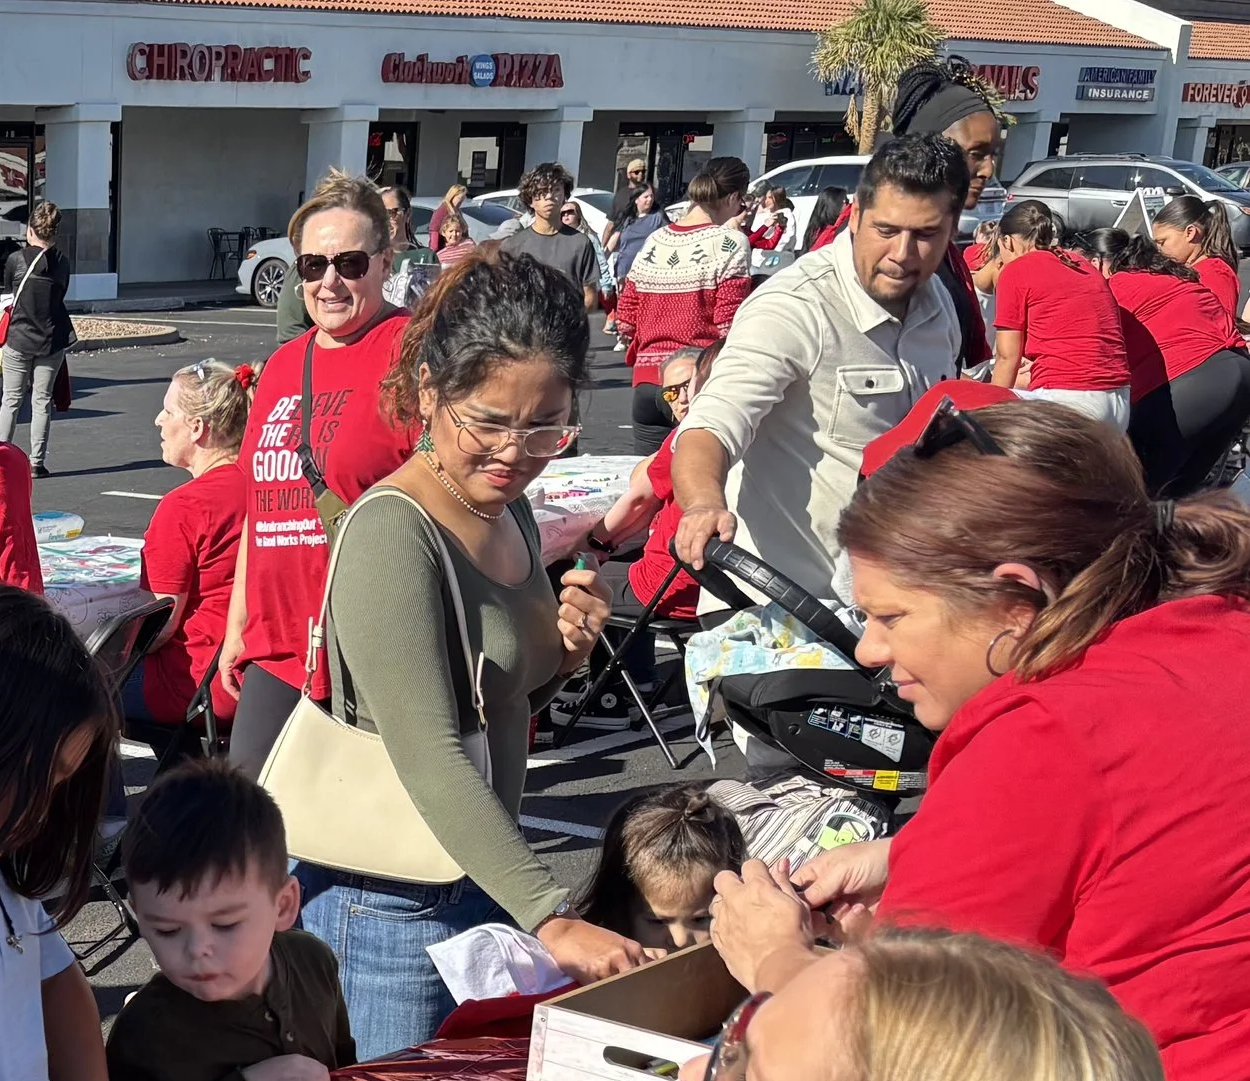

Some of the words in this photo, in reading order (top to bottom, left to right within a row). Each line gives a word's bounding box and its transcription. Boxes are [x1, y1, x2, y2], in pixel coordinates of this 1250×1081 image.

[127, 42, 312, 83] CHIROPRACTIC
[382, 53, 471, 85] Clockwork
[491, 53, 565, 88] PIZZA
[475, 60, 494, 70] WINGS
[473, 71, 495, 81] SALADS
[1084, 67, 1127, 83] AMERICAN
[1128, 69, 1157, 84] FAMILY
[1088, 87, 1150, 99] INSURANCE
[1186, 82, 1239, 104] FOREVER
[267, 389, 354, 423] BELEVE
[258, 423, 302, 449] THER
[317, 420, 340, 444] IS
[252, 450, 303, 483] GOOD
[255, 489, 274, 513] THE
[277, 486, 316, 511] WORL
[276, 533, 299, 547] Works
